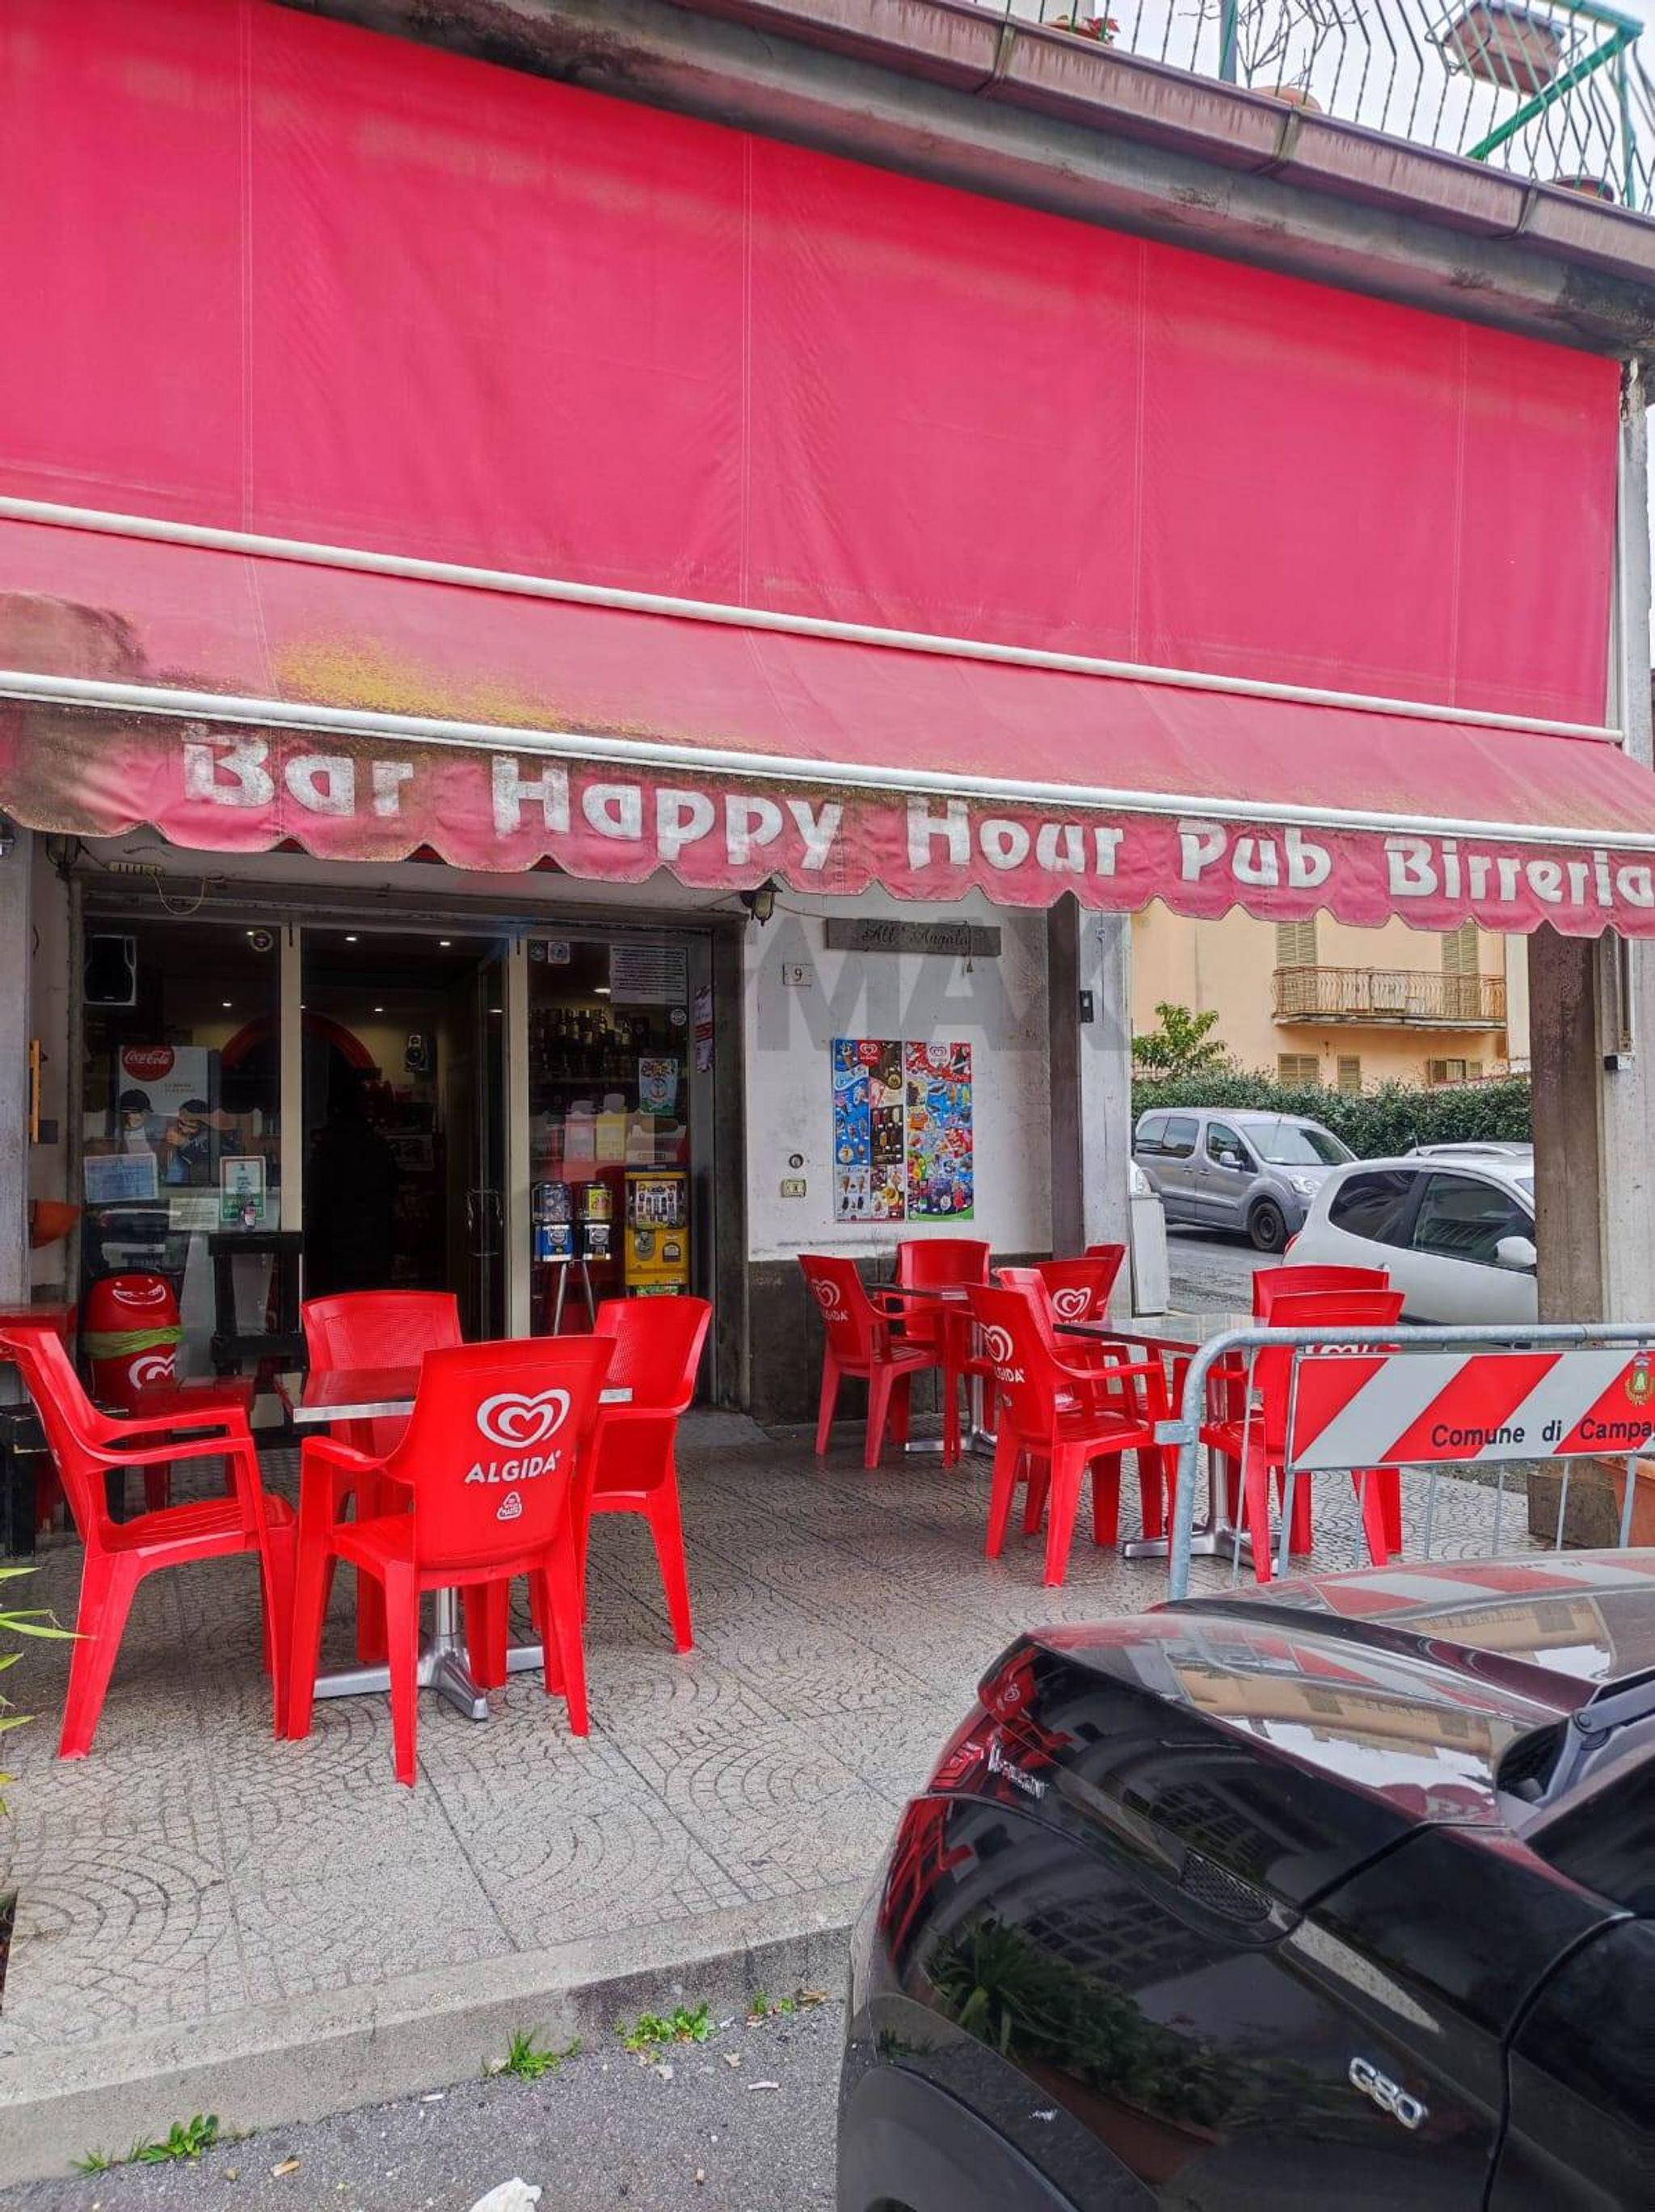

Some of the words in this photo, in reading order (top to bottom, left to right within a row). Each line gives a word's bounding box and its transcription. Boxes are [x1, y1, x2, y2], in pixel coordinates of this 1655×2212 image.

[182, 724, 414, 817] Bar
[492, 755, 843, 870] Happy
[907, 797, 1124, 876] Hour
[1177, 819, 1332, 888] Pub
[1384, 837, 1655, 908] Birreria
[794, 967, 803, 982] 9
[1431, 1424, 1526, 1448] Comune
[1542, 1419, 1562, 1442] di
[1580, 1418, 1655, 1443] Campa
[465, 1450, 559, 1484] ALGIDA
